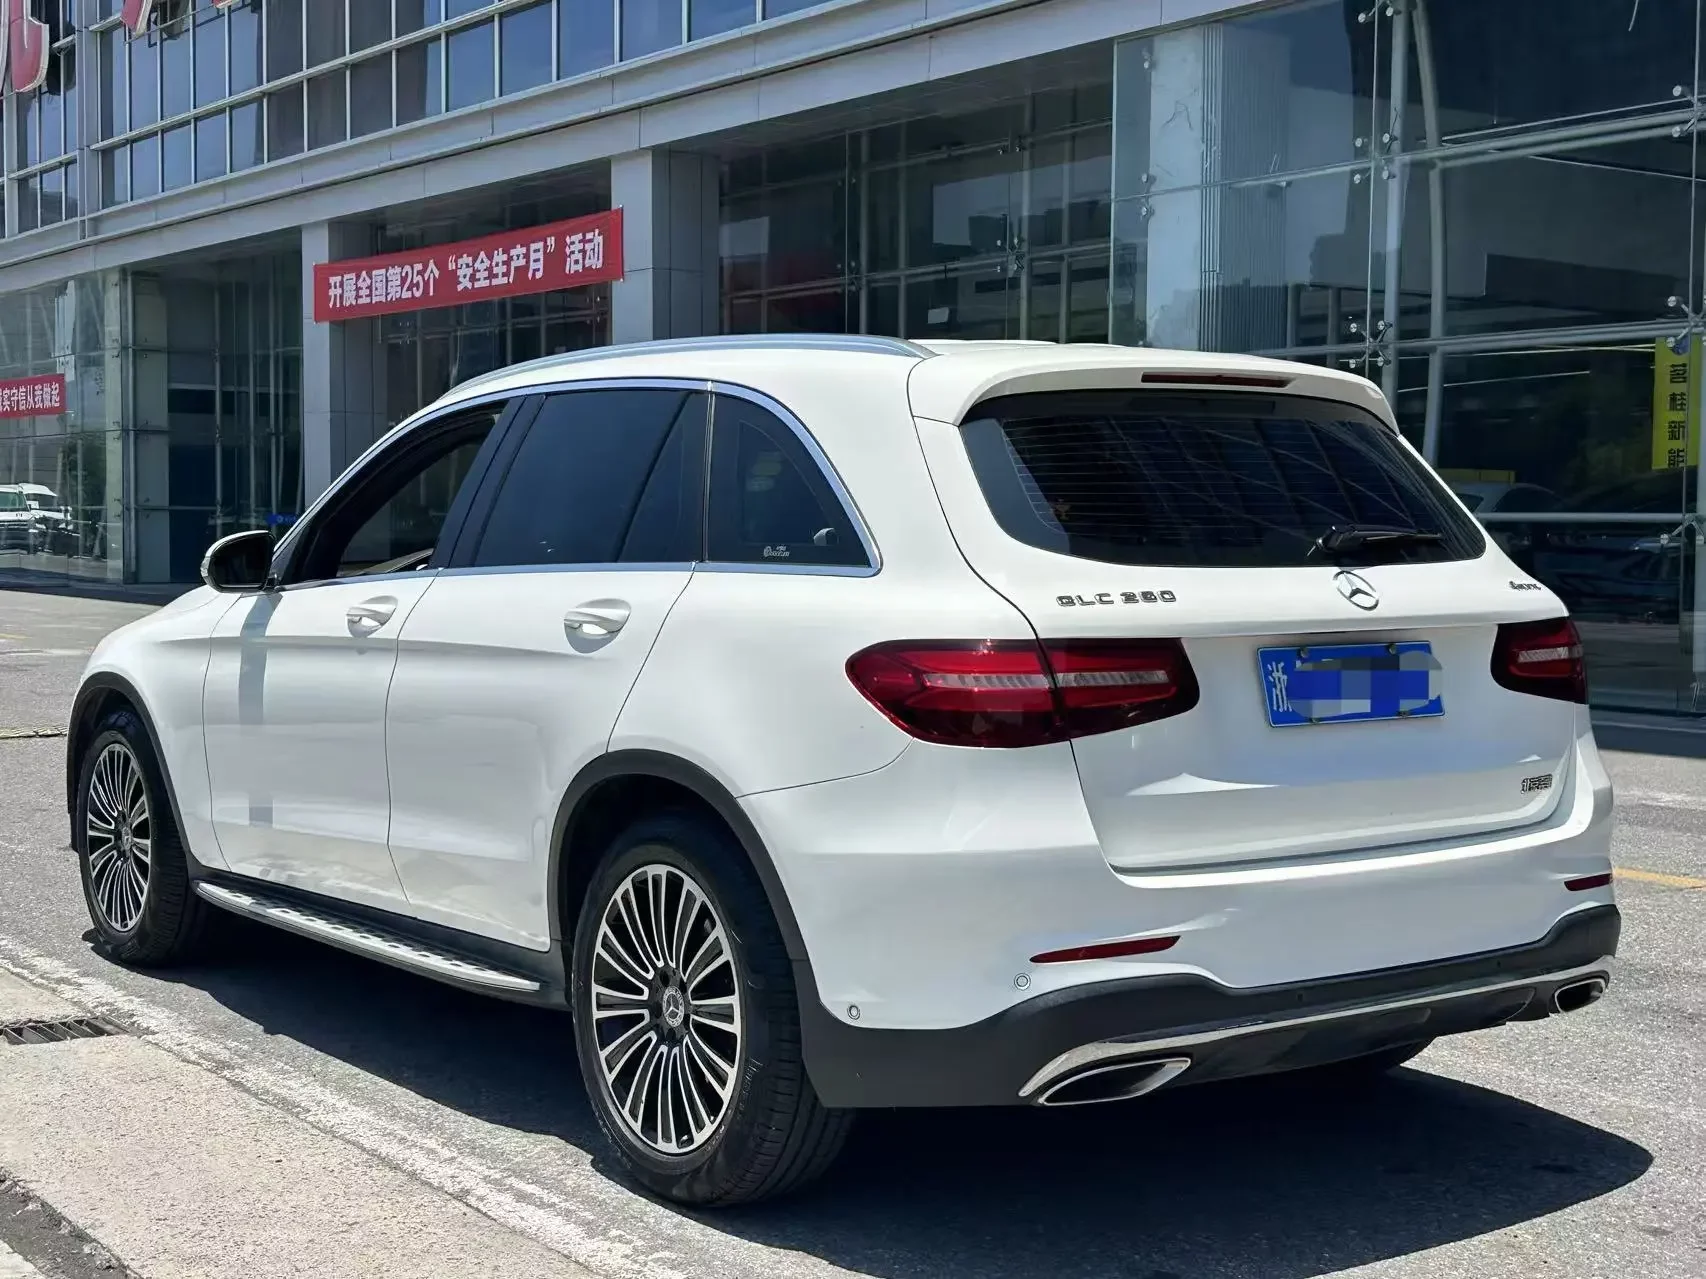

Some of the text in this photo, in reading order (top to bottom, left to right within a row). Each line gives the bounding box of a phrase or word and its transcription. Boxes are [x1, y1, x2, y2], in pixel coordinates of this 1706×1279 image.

[328, 228, 604, 308] 开展全国第25个“安全生产月”活动
[0, 381, 60, 412] 实守信从我做起
